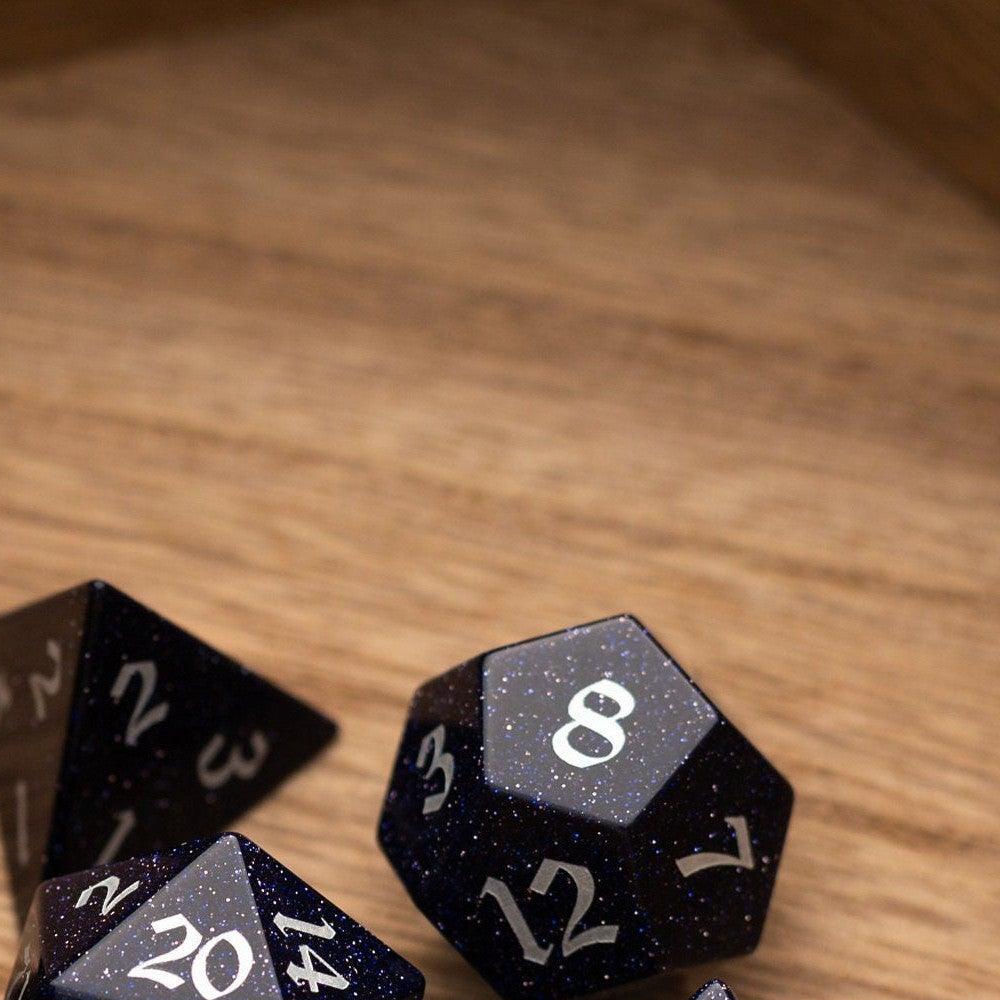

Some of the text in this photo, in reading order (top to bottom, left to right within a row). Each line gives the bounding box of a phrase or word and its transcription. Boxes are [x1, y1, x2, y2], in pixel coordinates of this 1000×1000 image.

[110, 659, 169, 747] 2
[551, 678, 636, 768] 8
[196, 730, 269, 789] 3
[417, 724, 455, 815] 3
[675, 814, 755, 878] 7
[75, 875, 140, 916] 2
[479, 858, 620, 966] 12
[127, 913, 256, 1000] 20
[273, 912, 351, 993] 14
